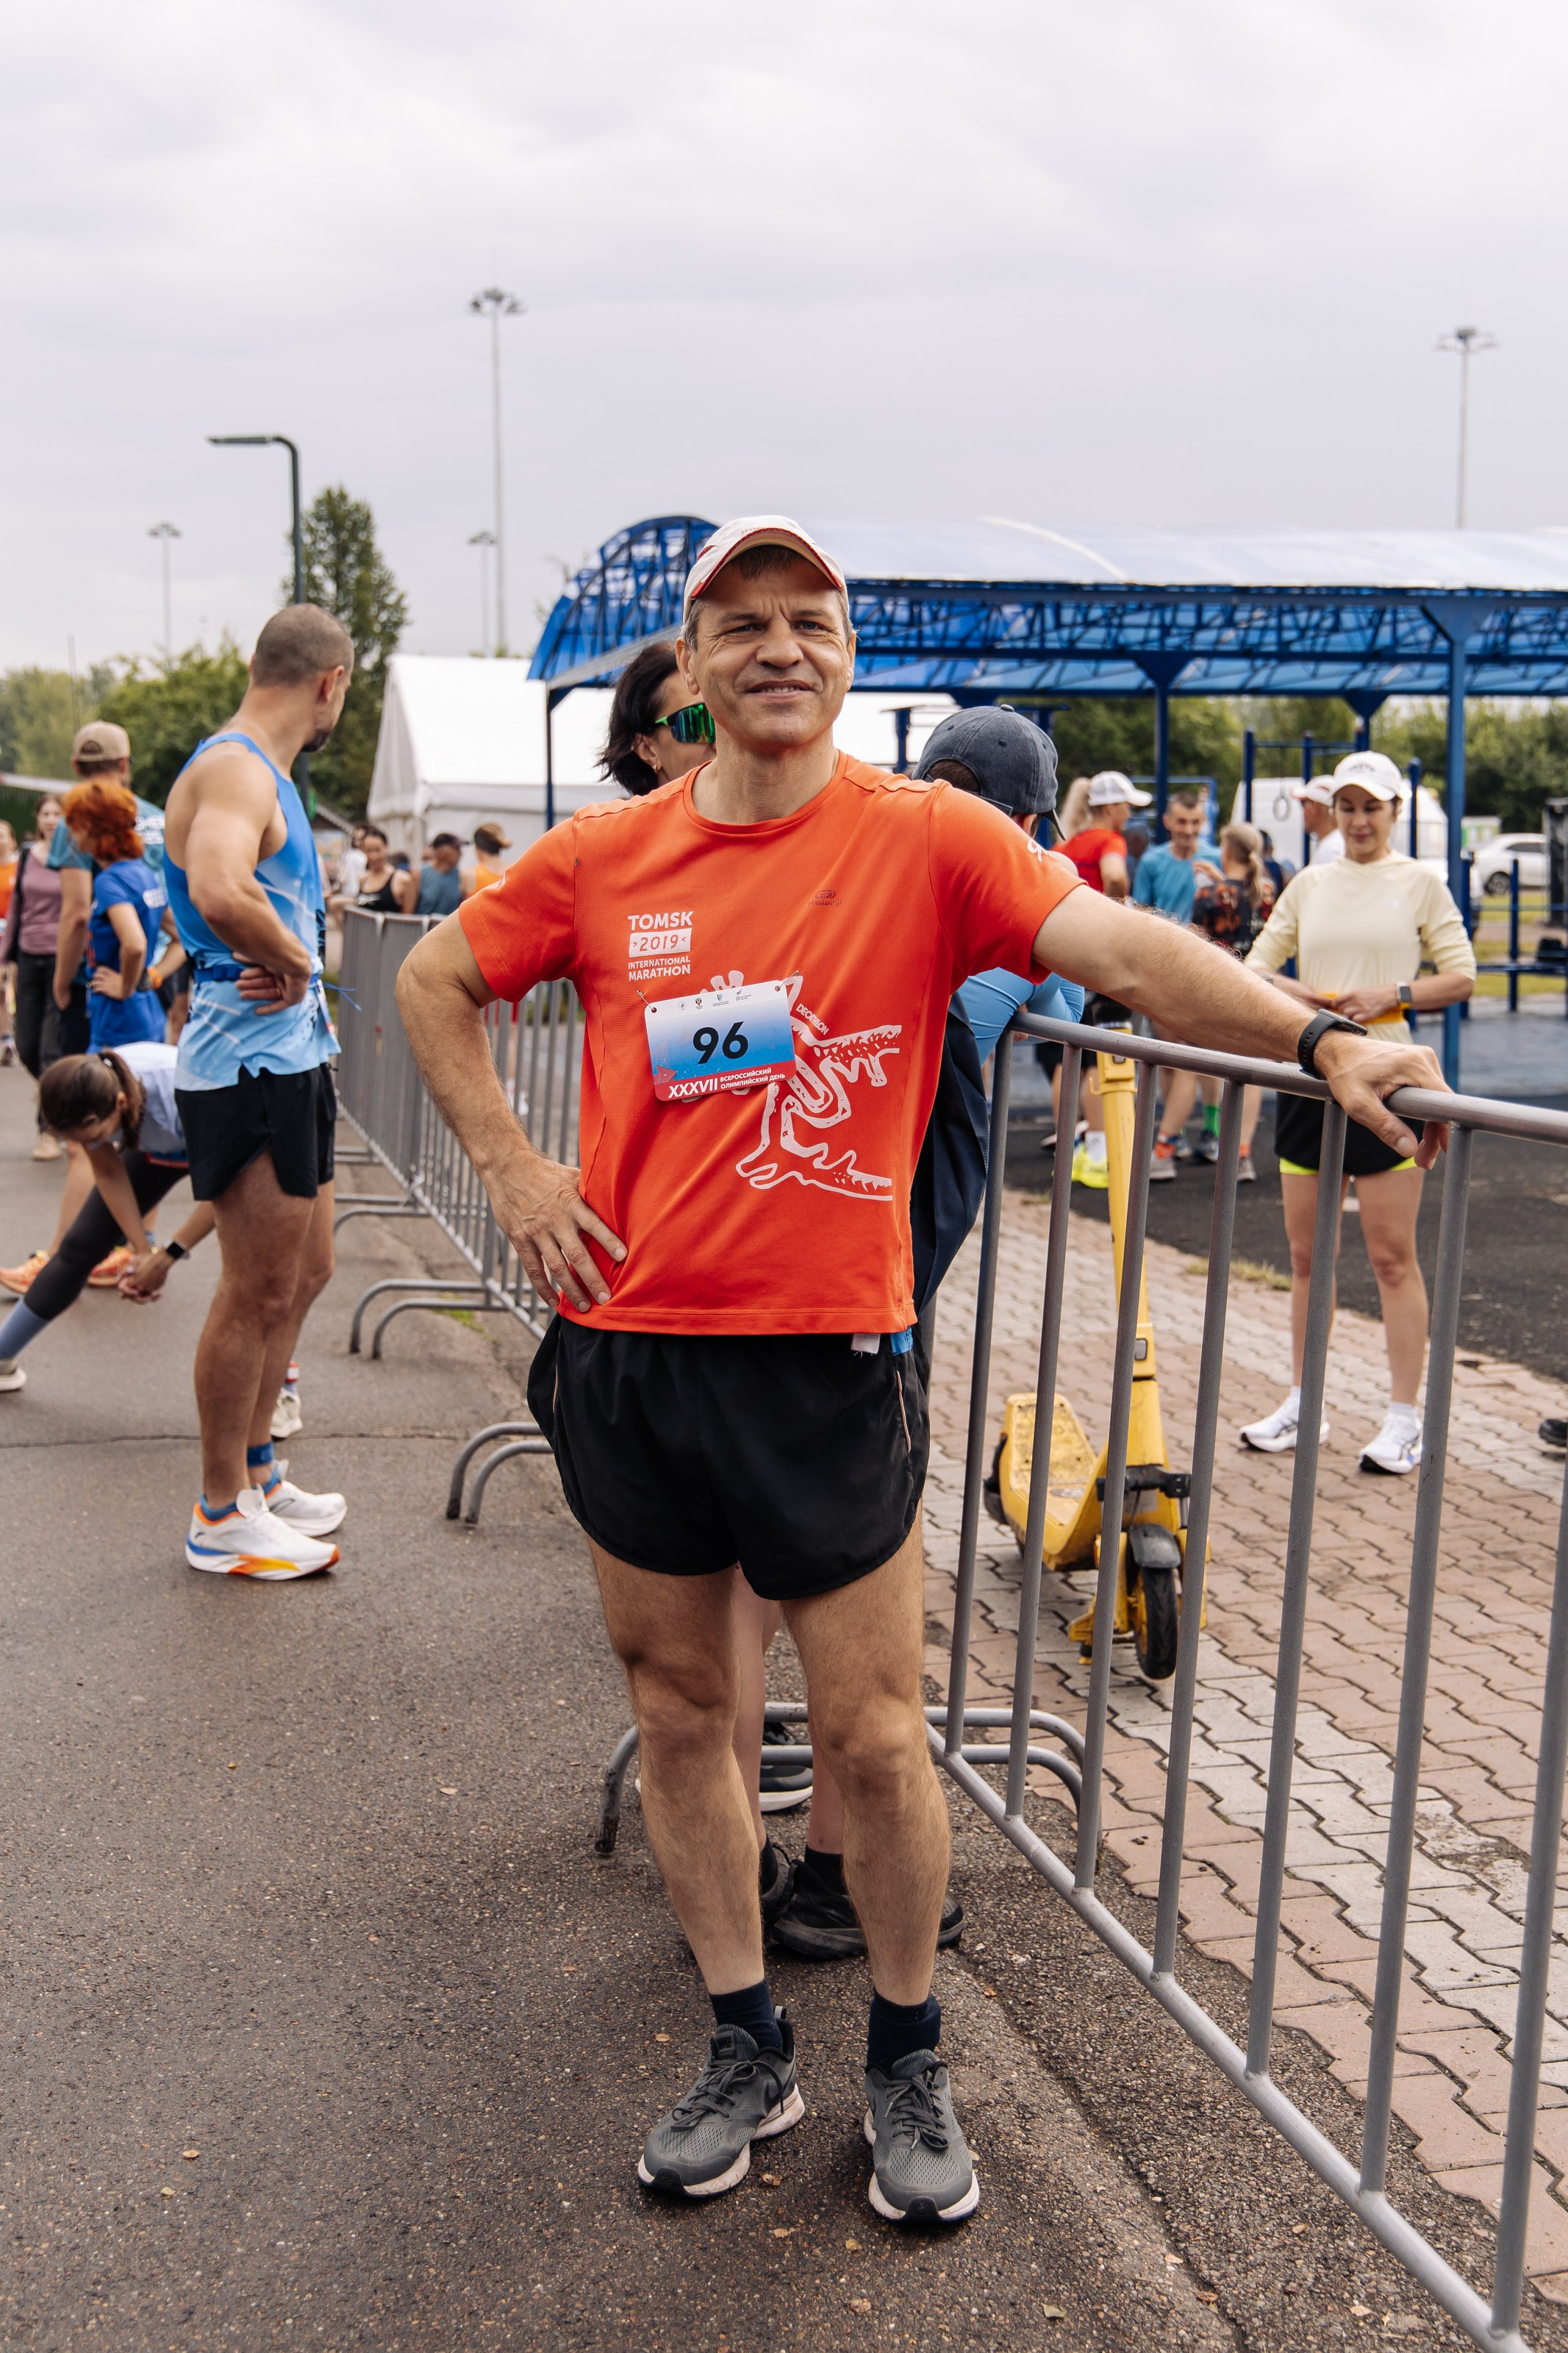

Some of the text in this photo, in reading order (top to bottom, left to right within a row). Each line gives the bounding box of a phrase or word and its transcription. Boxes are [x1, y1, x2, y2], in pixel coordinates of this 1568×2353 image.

[627, 911, 693, 931] TOMSK
[628, 955, 691, 970] INTERNATIONAL
[629, 964, 691, 982] MARATHON
[795, 1003, 829, 1035] DECATHLON
[692, 1021, 748, 1065] 96
[720, 1067, 772, 1082] ВСЕРОССИЙСКИЙ
[720, 1073, 786, 1090] ОЛИМПИЙСКИЙ ДЕНЬ
[668, 1078, 718, 1099] XXXVII
